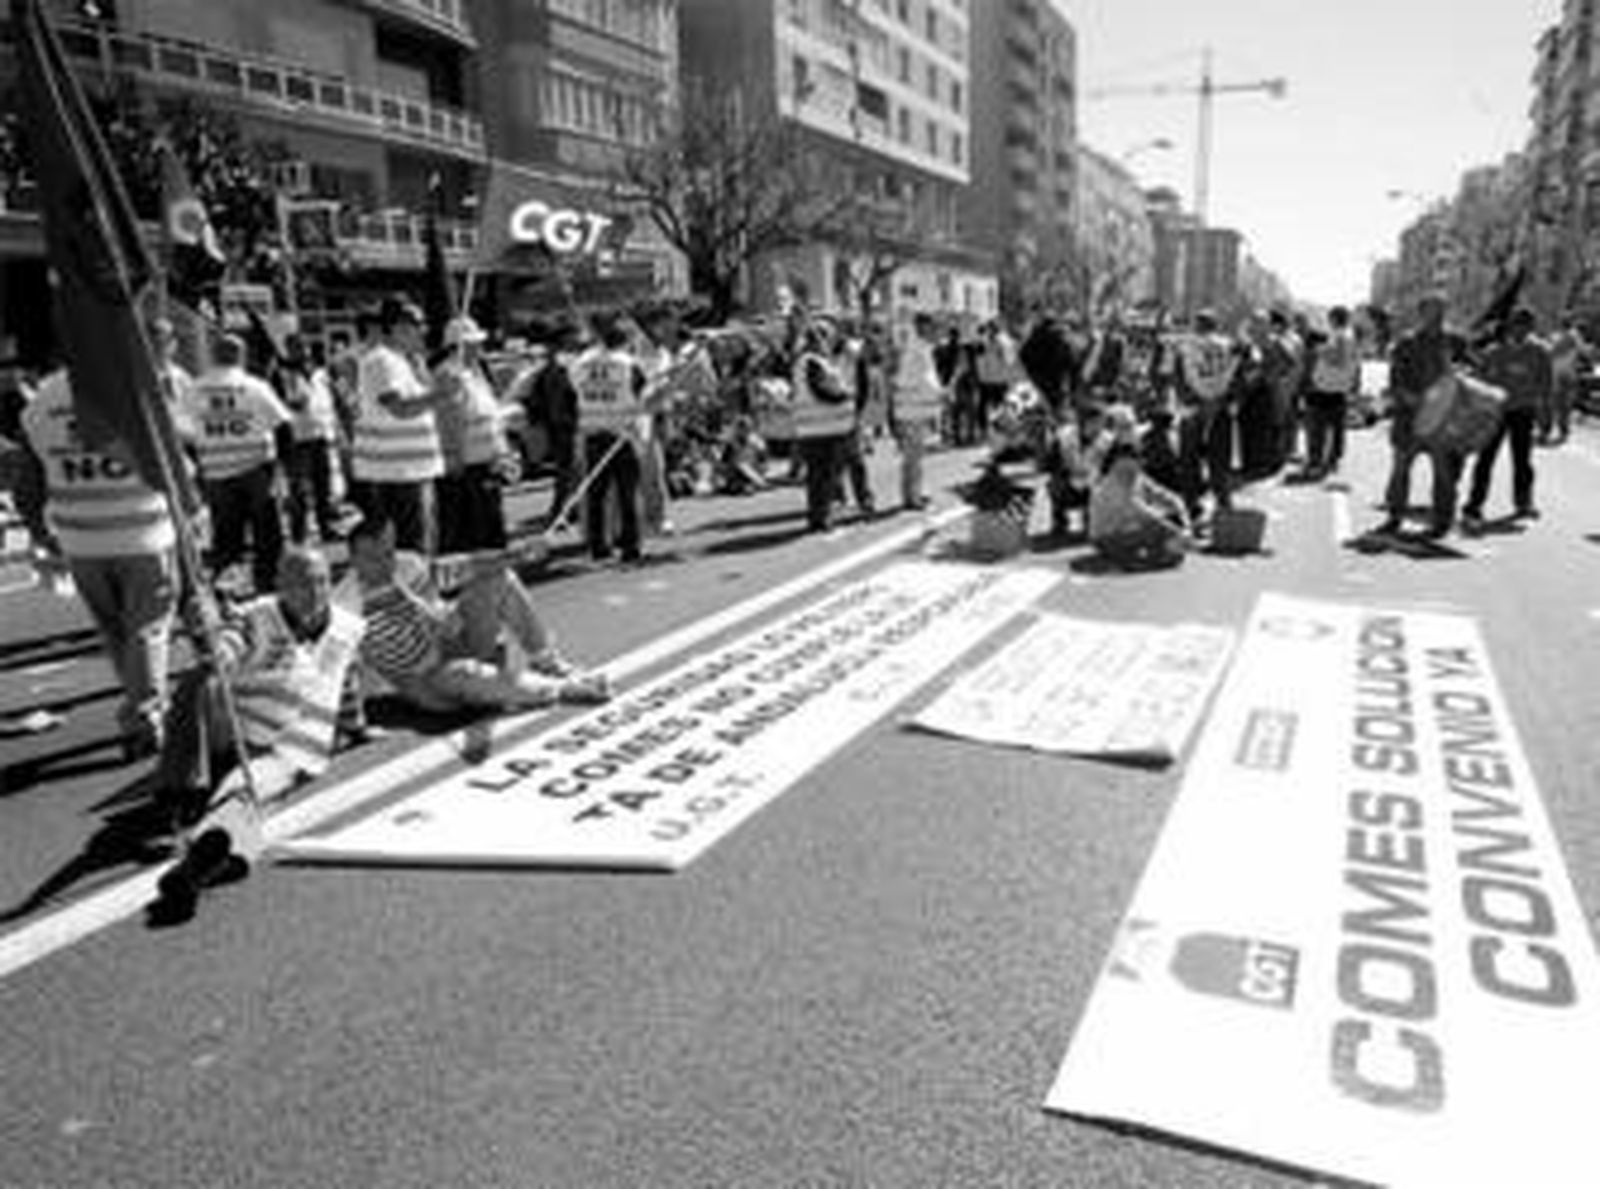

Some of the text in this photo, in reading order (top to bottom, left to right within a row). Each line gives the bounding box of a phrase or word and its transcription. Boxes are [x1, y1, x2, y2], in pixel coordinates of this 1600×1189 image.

[509, 200, 614, 253] CGT
[465, 758, 553, 793] LA
[538, 715, 703, 800] COMES
[643, 747, 724, 786] DE
[1424, 648, 1578, 1008] CONVENIO YA
[1238, 942, 1298, 1003] CGT
[1330, 789, 1446, 1113] COMES
